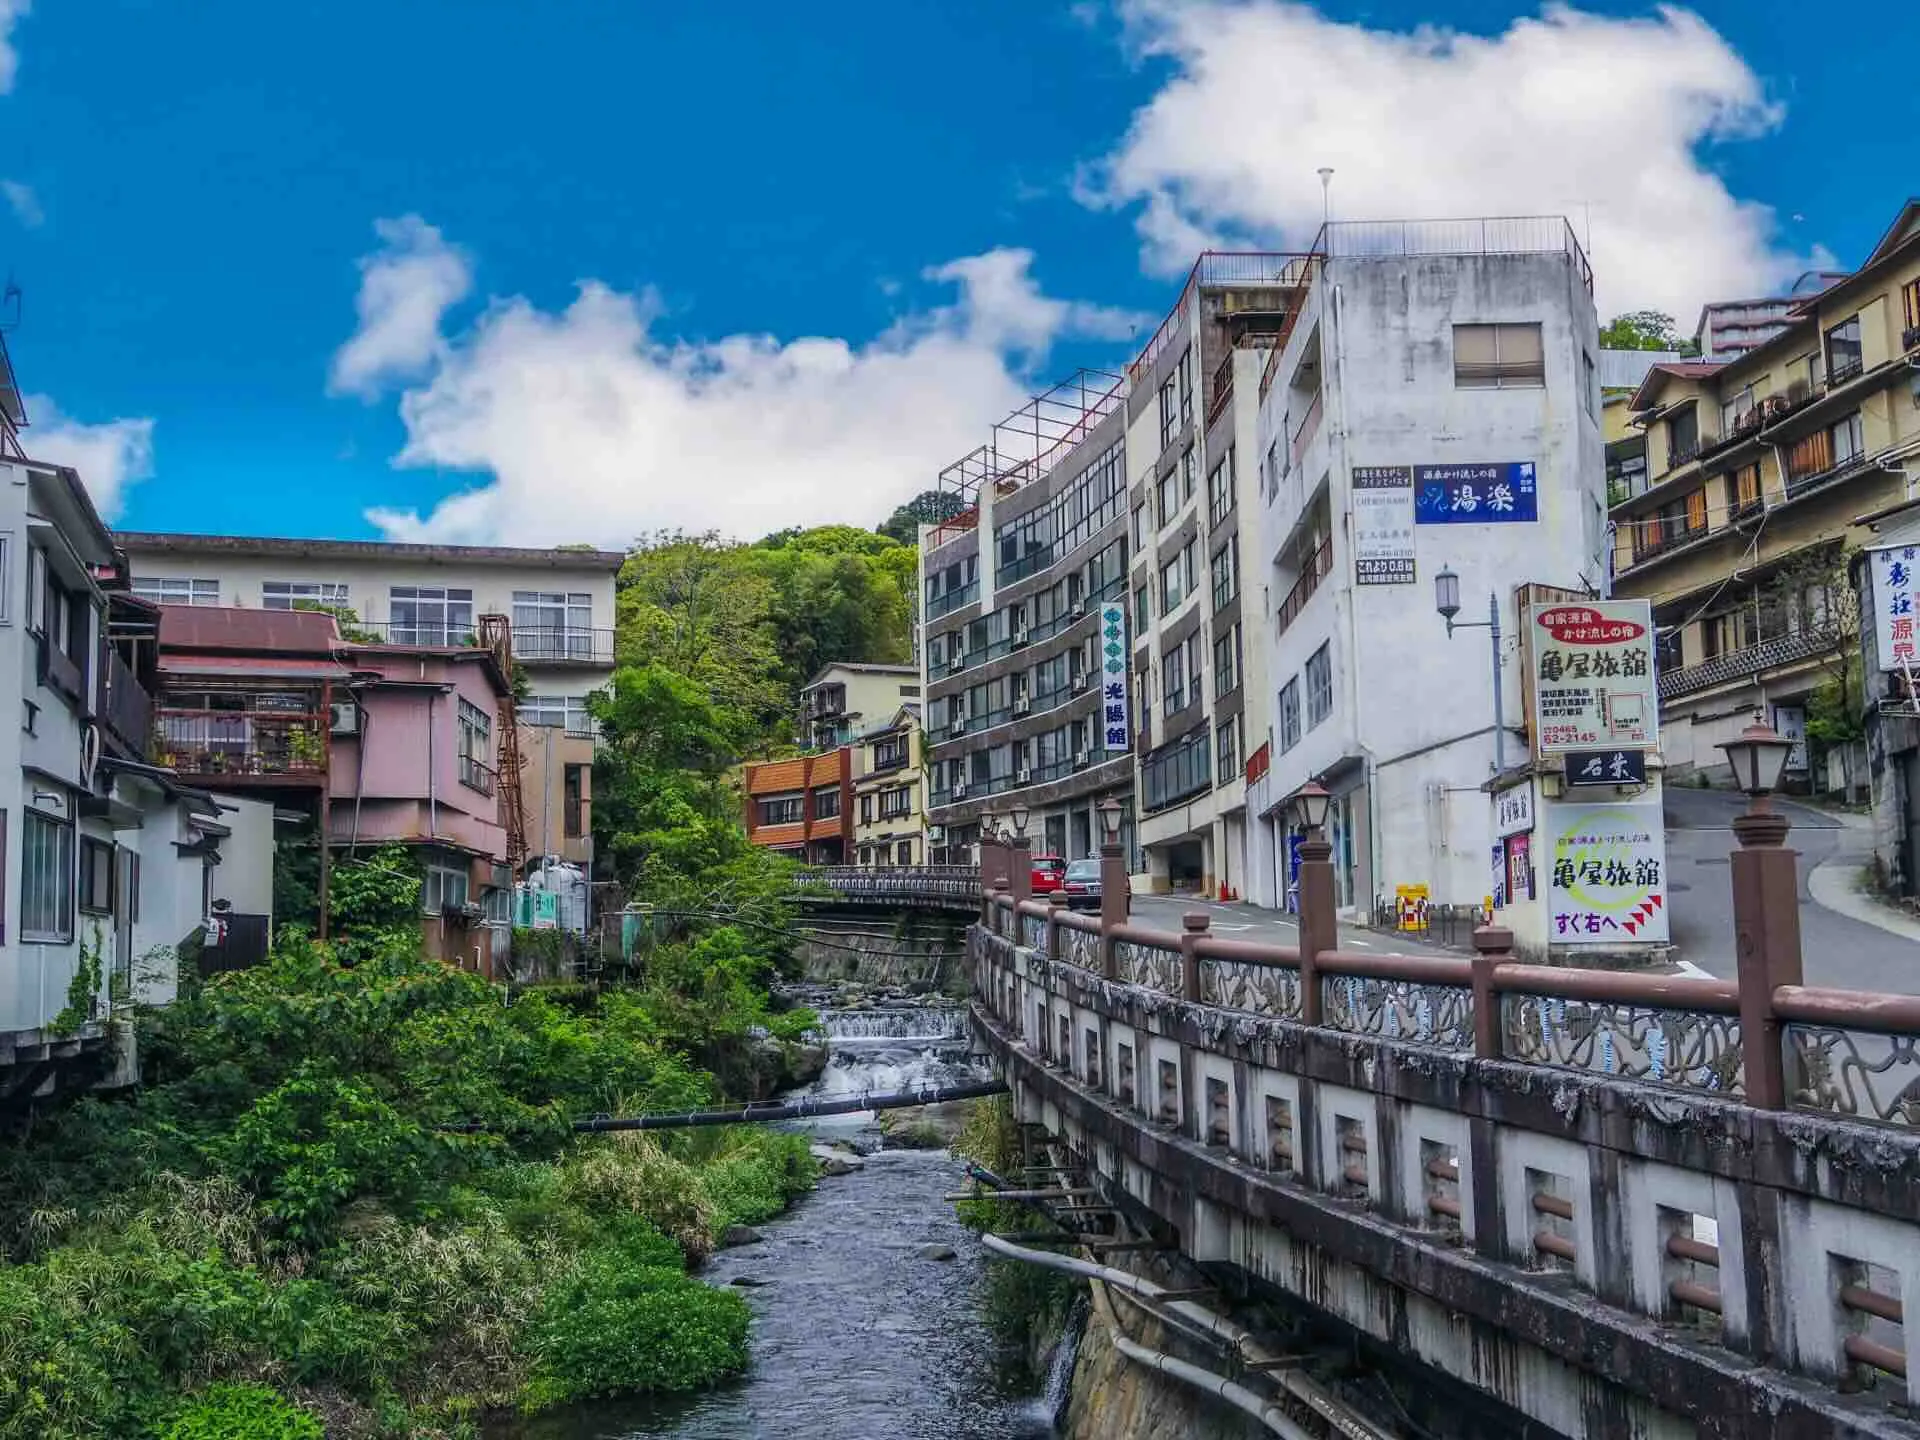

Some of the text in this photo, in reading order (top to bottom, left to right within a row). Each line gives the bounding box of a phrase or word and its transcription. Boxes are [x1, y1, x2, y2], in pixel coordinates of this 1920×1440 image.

[1451, 483, 1514, 513] 湯楽
[1563, 625, 1635, 640] かけ流しの宿
[1891, 618, 1914, 664] 源泉
[1540, 647, 1648, 682] 亀屋旅館
[1105, 682, 1126, 745] 光陽館
[1544, 732, 1597, 745] 62-2145
[1552, 857, 1660, 889] 亀屋旅館
[1555, 912, 1618, 934] すぐ右へ
